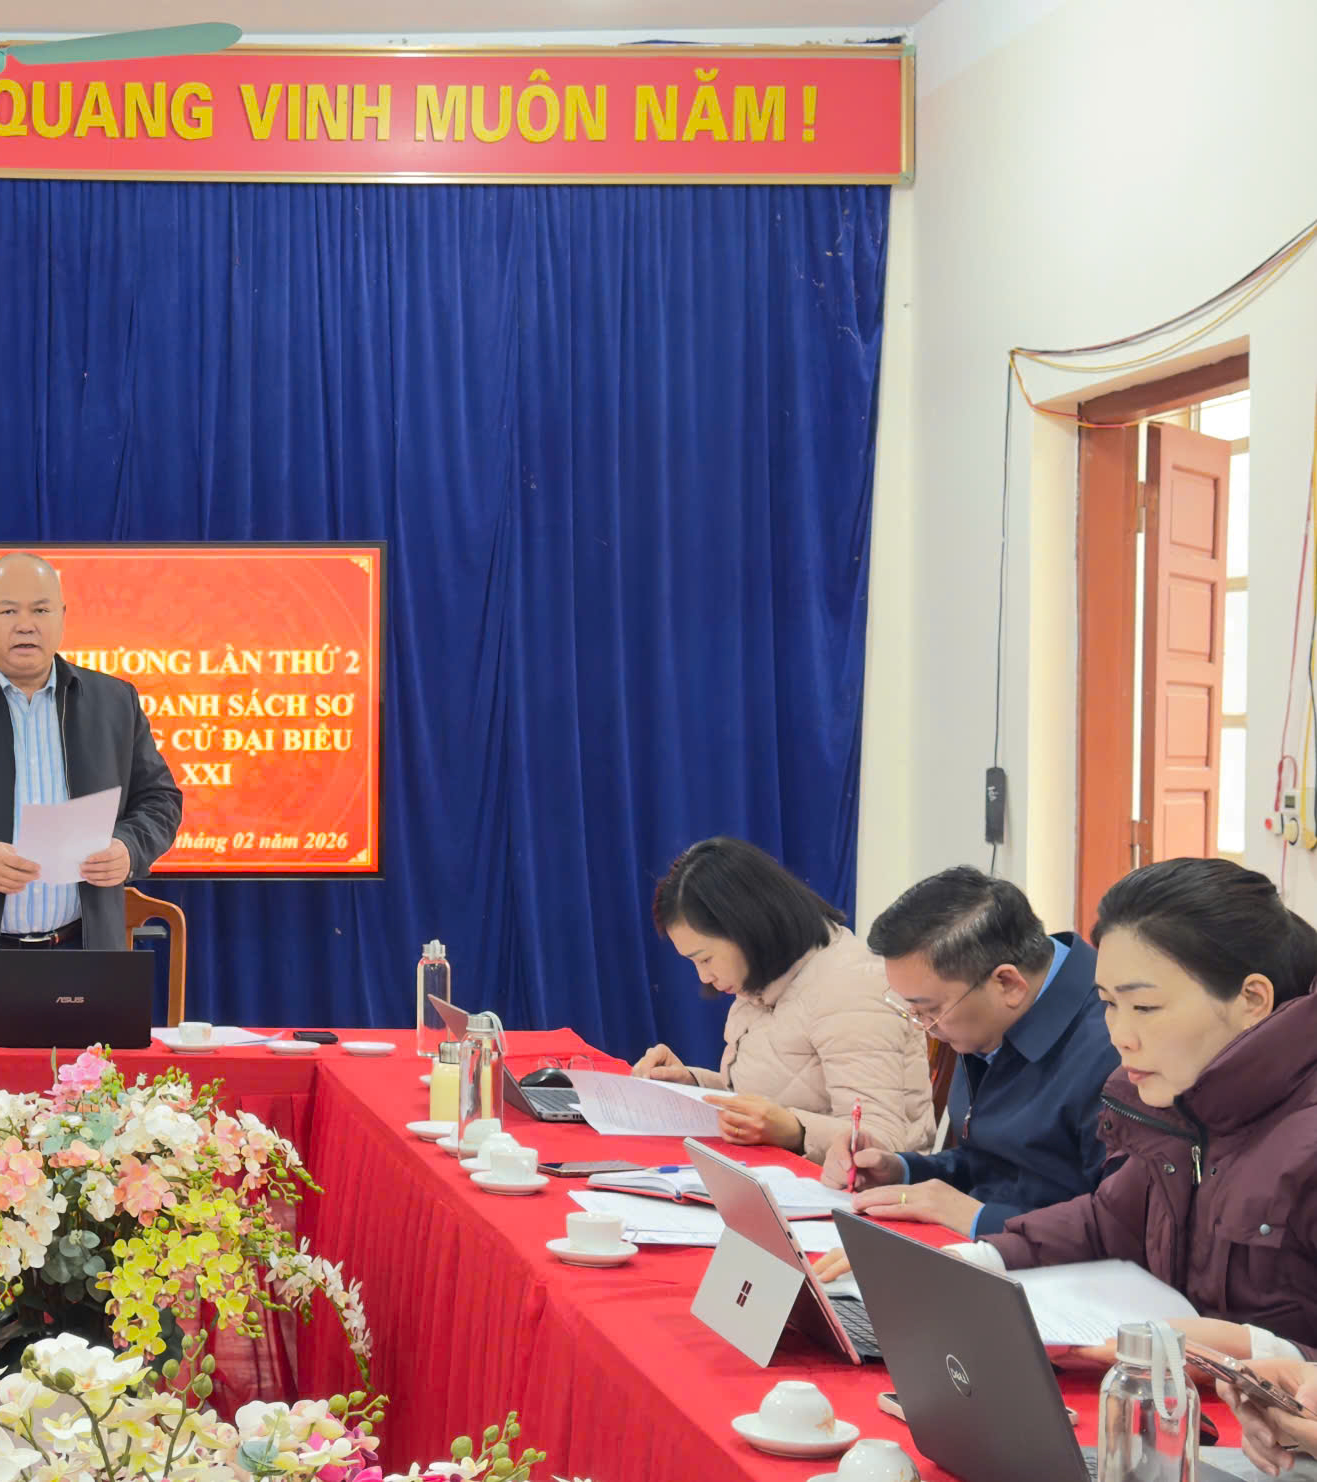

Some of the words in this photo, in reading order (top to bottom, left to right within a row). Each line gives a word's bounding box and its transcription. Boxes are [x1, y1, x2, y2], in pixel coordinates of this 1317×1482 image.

[239, 83, 392, 141] VINH
[414, 68, 608, 143] MUÔN
[198, 643, 262, 675] LẦN
[268, 643, 342, 675] THỨ
[345, 650, 361, 674] 2
[138, 694, 221, 717] DANH
[228, 688, 307, 717] SÁCH
[314, 693, 355, 717] SƠ
[171, 722, 218, 751] CỬ
[222, 729, 275, 757] ĐẠI
[180, 763, 233, 785] XXI
[175, 832, 229, 853] tháng
[232, 832, 256, 849] 02
[259, 832, 299, 849] năm
[303, 832, 349, 849] 2026
[56, 996, 85, 1004] ASUS
